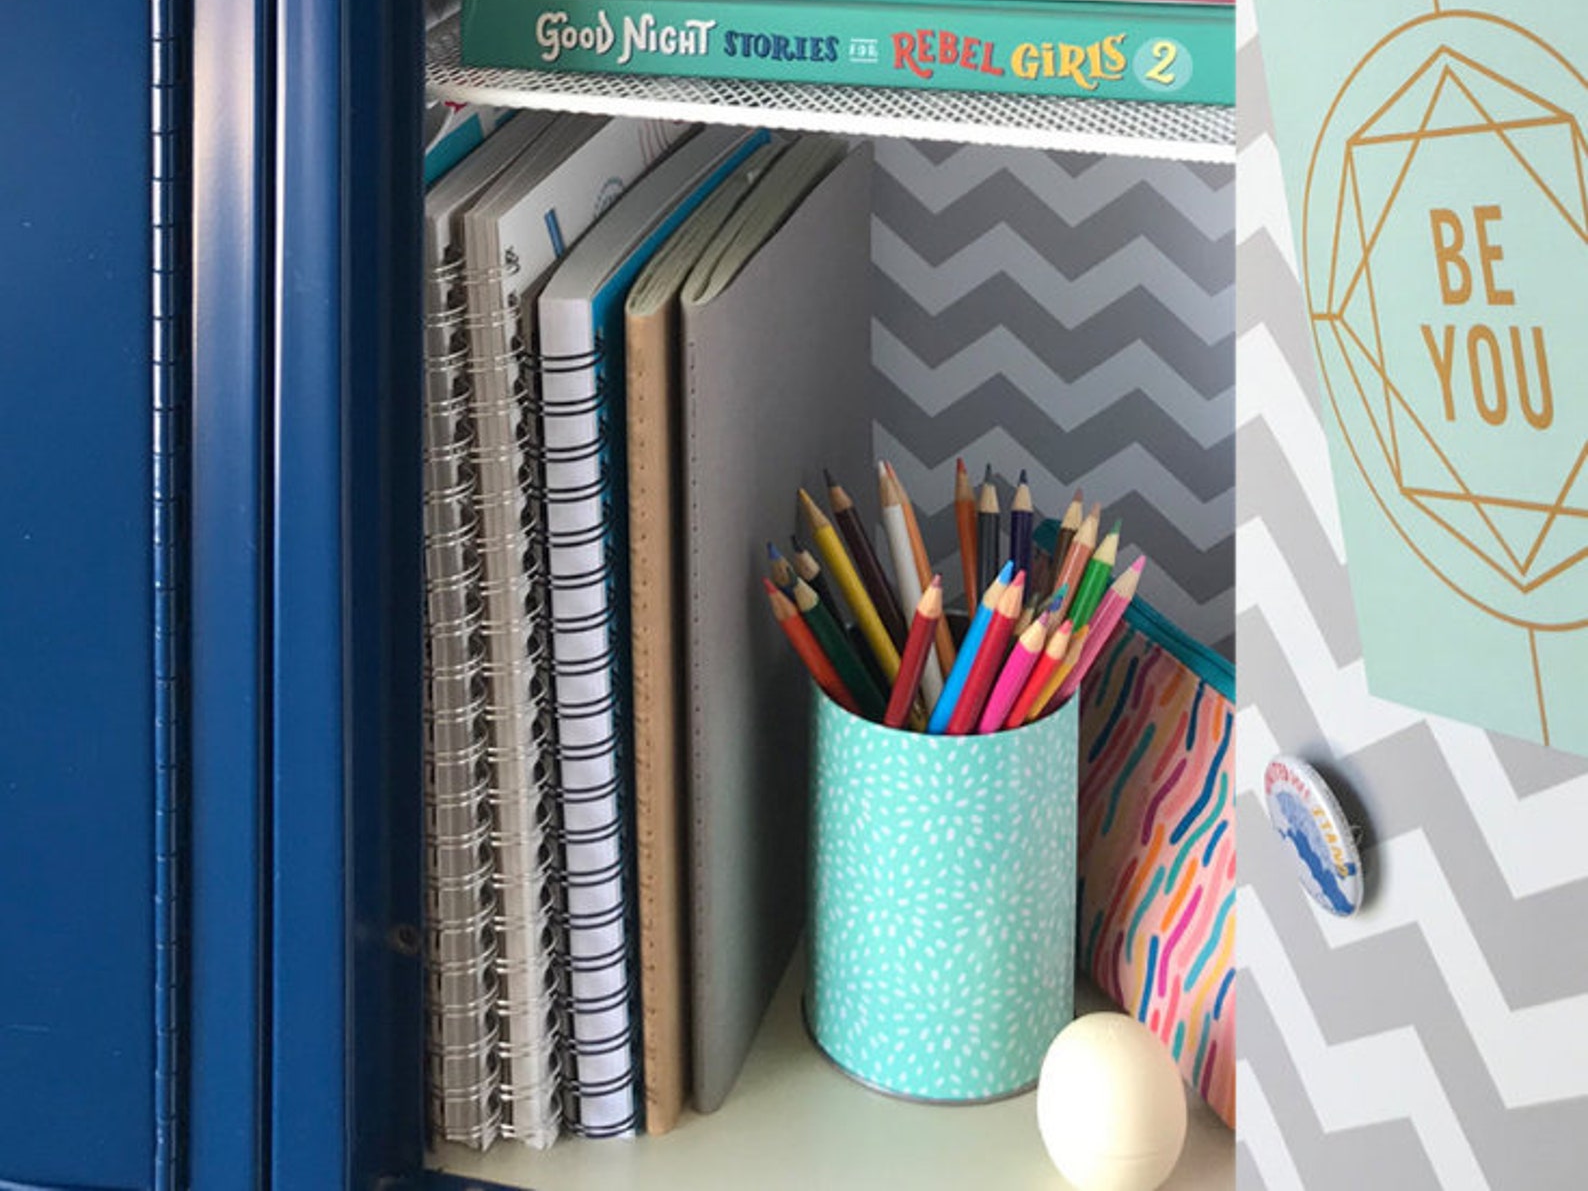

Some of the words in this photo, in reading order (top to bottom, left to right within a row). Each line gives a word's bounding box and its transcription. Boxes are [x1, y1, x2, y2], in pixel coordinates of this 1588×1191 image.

[724, 29, 840, 61] STORIES
[890, 28, 1004, 79] REBEL
[1145, 40, 1179, 85] 2
[1429, 204, 1515, 306] BE
[1420, 323, 1555, 431] YOU
